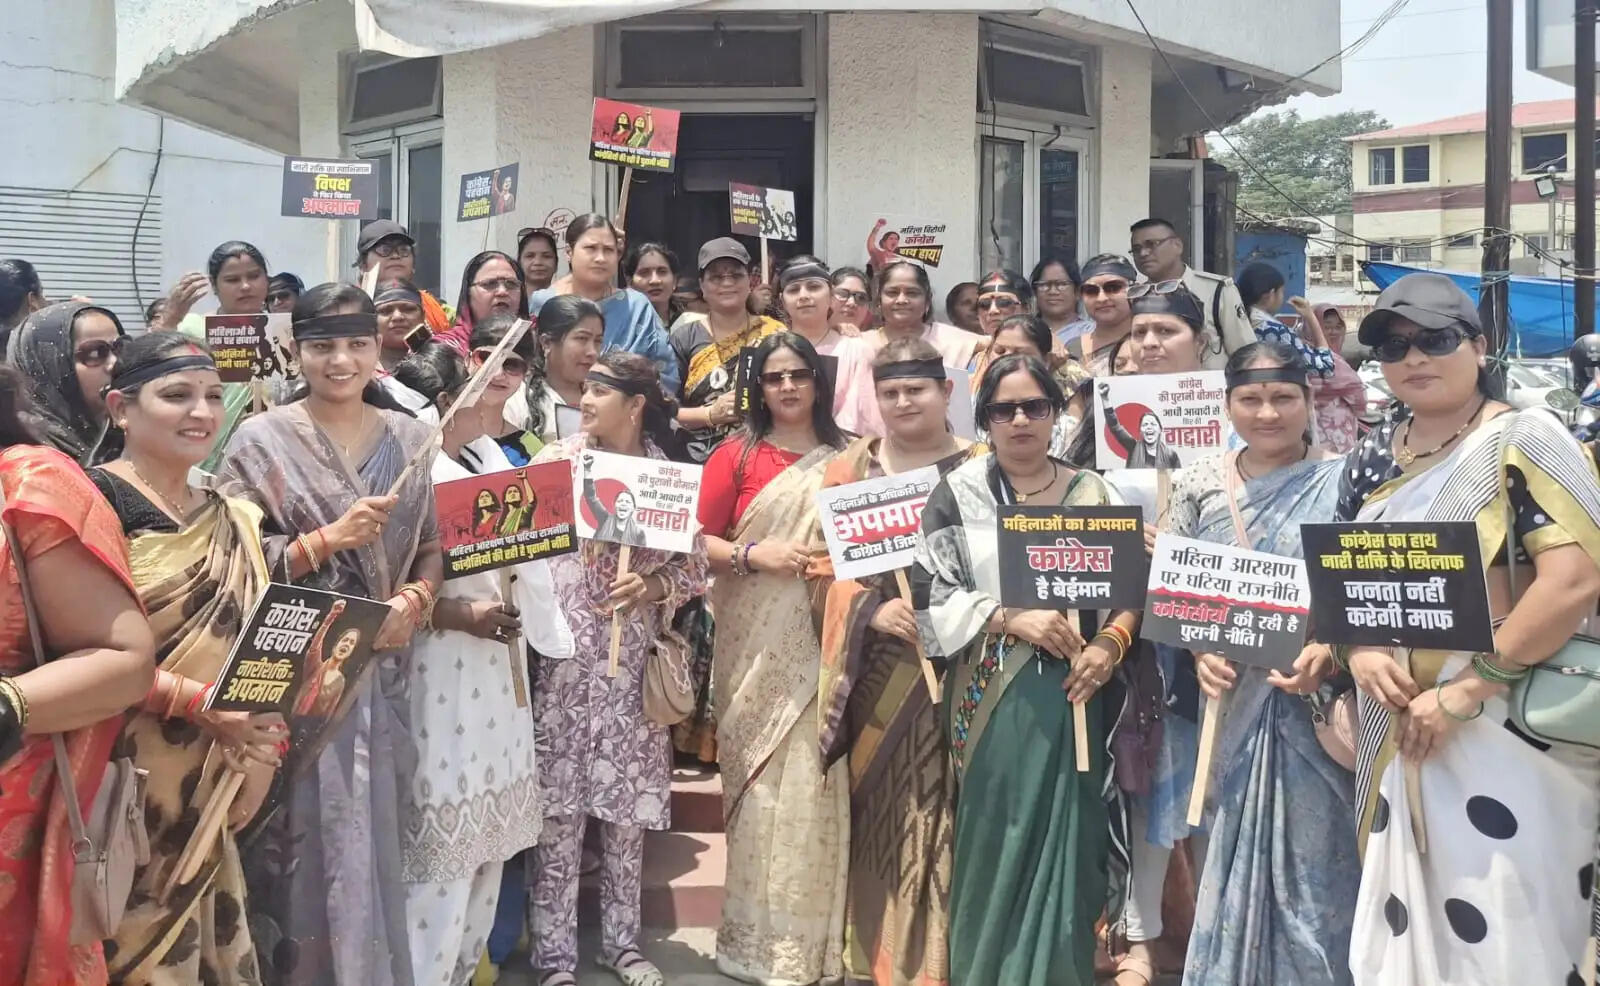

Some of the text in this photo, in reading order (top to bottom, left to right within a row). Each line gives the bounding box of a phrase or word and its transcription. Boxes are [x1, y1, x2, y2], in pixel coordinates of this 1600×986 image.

[315, 173, 351, 192] विपक्ष
[465, 186, 491, 198] पहचान
[466, 176, 490, 190] कांग्रेस
[302, 197, 361, 216] अपमान
[462, 206, 490, 218] अपमान
[900, 224, 946, 234] महिला विरोधी
[208, 324, 256, 337] महिलाओं के
[208, 335, 260, 345] हक पर सवाल
[233, 360, 249, 369] चाल
[1178, 377, 1203, 389] कांग्रेस
[1159, 388, 1224, 405] की पुरानी बीमारी
[1163, 405, 1220, 417] आधी आबादी से
[1163, 419, 1221, 448] गद्दारी
[658, 465, 682, 478] कांग्रेस
[638, 473, 699, 491] की पुरानी बीमारी
[639, 489, 693, 504] आधी आबादी से
[830, 481, 930, 512] महिलाओं के अधिकारों का
[636, 507, 690, 533] गद्दारी
[1002, 514, 1137, 532] महिलाओं का अपमान
[450, 523, 570, 557] महिला आरक्षण पर घटिया राजनीति
[848, 543, 883, 560] कांग्रेस
[883, 537, 893, 553] है
[1339, 530, 1437, 549] कांग्रेस का हाथ
[451, 534, 570, 572] कांग्रेसियों की रही है पुरानी नीति
[1026, 537, 1114, 573] कांग्रेस
[1170, 546, 1297, 580] महिला आरक्षण
[1320, 550, 1464, 571] नारी शक्ति के खिलाफ
[1035, 575, 1111, 602] है बेईमान
[1160, 571, 1300, 602] पर घटिया राजनीति
[1344, 576, 1447, 603] जनता नहीं
[265, 599, 320, 632] कांग्रेस
[1233, 610, 1255, 628] की
[1257, 614, 1283, 632] रही
[1286, 614, 1299, 633] है
[1345, 602, 1454, 630] करेगी माफ
[253, 627, 313, 655] पहचान
[1180, 624, 1221, 643] पुरानी
[236, 656, 293, 680] नारीशक्ति
[223, 678, 291, 704] अपमान
